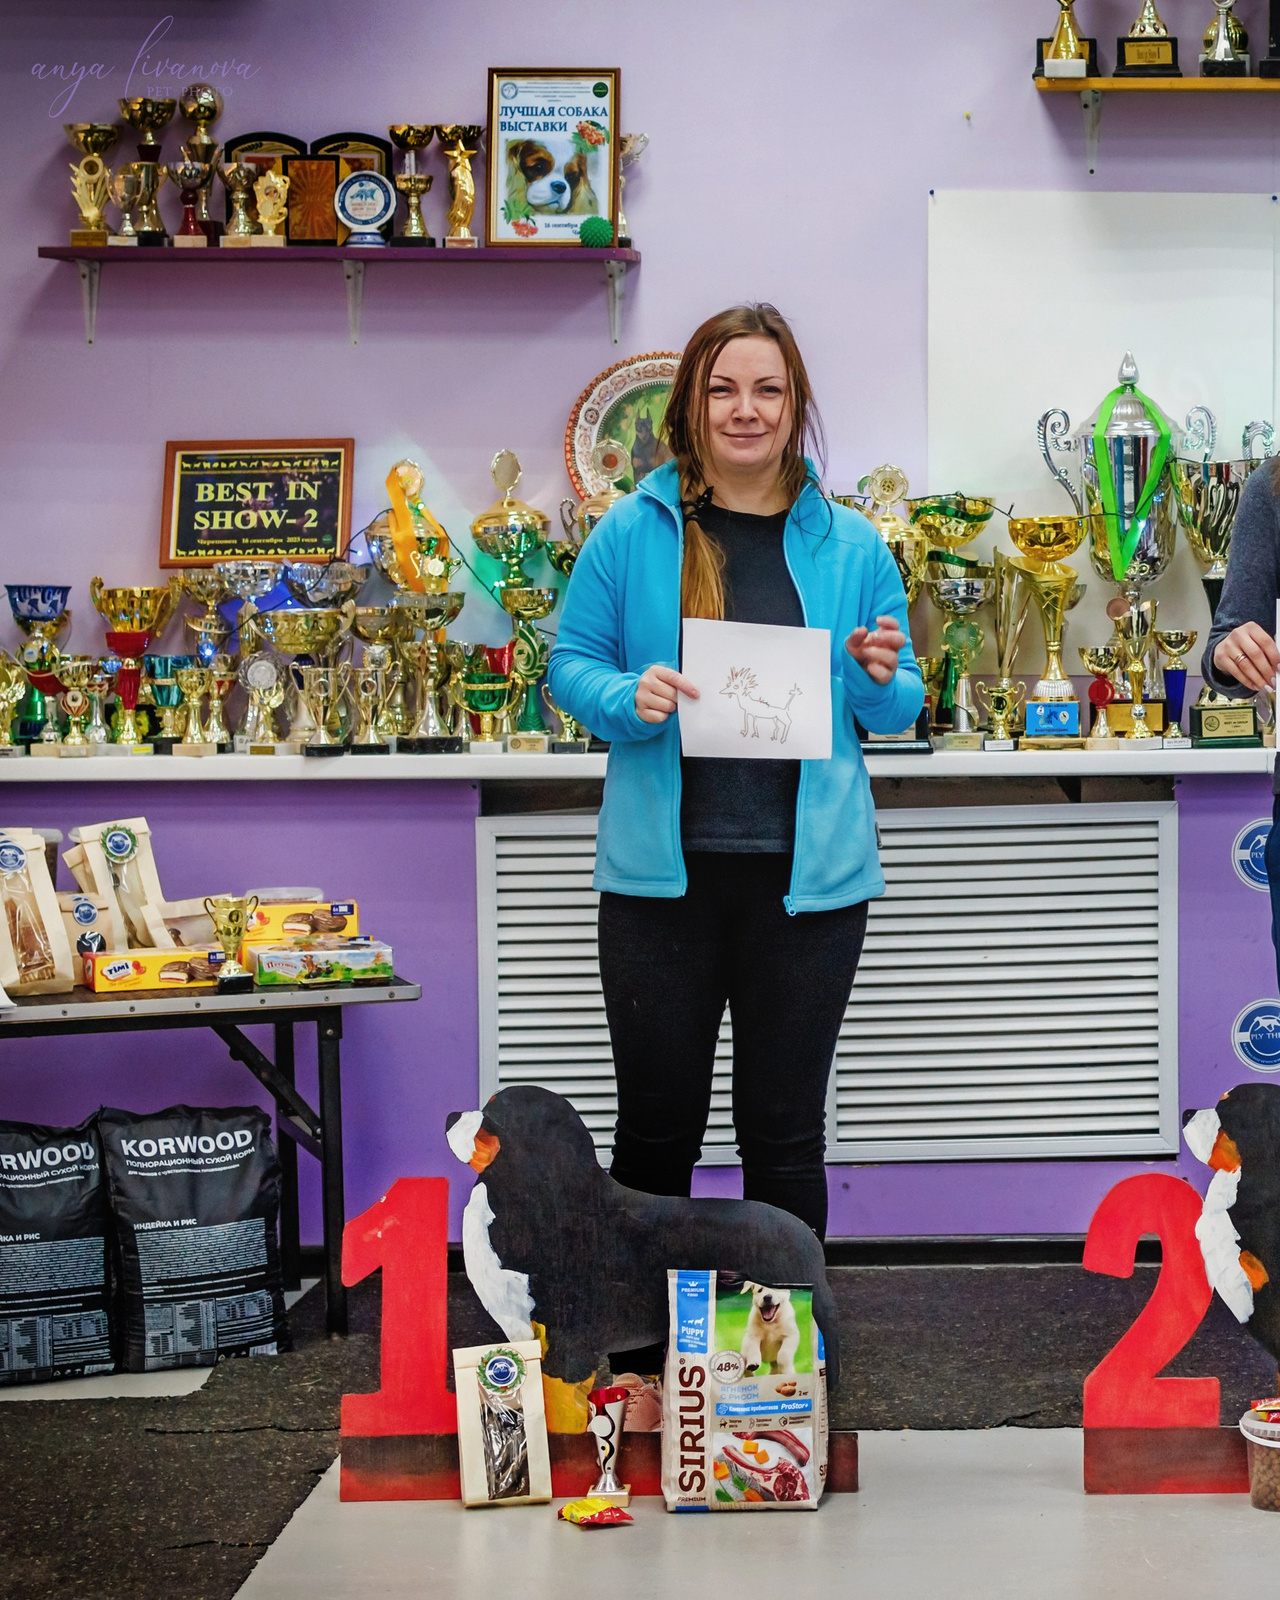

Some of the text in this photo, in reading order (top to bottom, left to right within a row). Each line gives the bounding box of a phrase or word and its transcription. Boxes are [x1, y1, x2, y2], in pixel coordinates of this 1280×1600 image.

[499, 106, 608, 119] ЛУЧШАЯ СОБАКА
[500, 121, 568, 132] ВЫСТАВКИ
[195, 480, 323, 503] BEST IN
[303, 508, 319, 528] 2
[249, 537, 284, 545] сентября
[121, 1129, 253, 1158] KORWOOD
[0, 1142, 95, 1171] RWOOD
[126, 1146, 255, 1169] ПОЛНОРАЦИОННЫЙ СУХОЙ КОРМ
[51, 1164, 79, 1176] СУХОЙ
[79, 1162, 100, 1171] КОРМ
[133, 1220, 172, 1231] ИНДЕЙКА
[181, 1218, 198, 1226] РИС
[23, 1232, 41, 1241] РИС
[341, 1177, 457, 1436] 1
[1082, 1173, 1220, 1428] 2
[681, 1325, 705, 1338] PUPPY
[716, 1362, 740, 1372] 48%
[720, 1383, 759, 1392] ЯГНЕНОК
[728, 1393, 760, 1401] РИСОМ
[780, 1402, 809, 1411] ProStor+
[678, 1365, 706, 1493] SIRIUS
